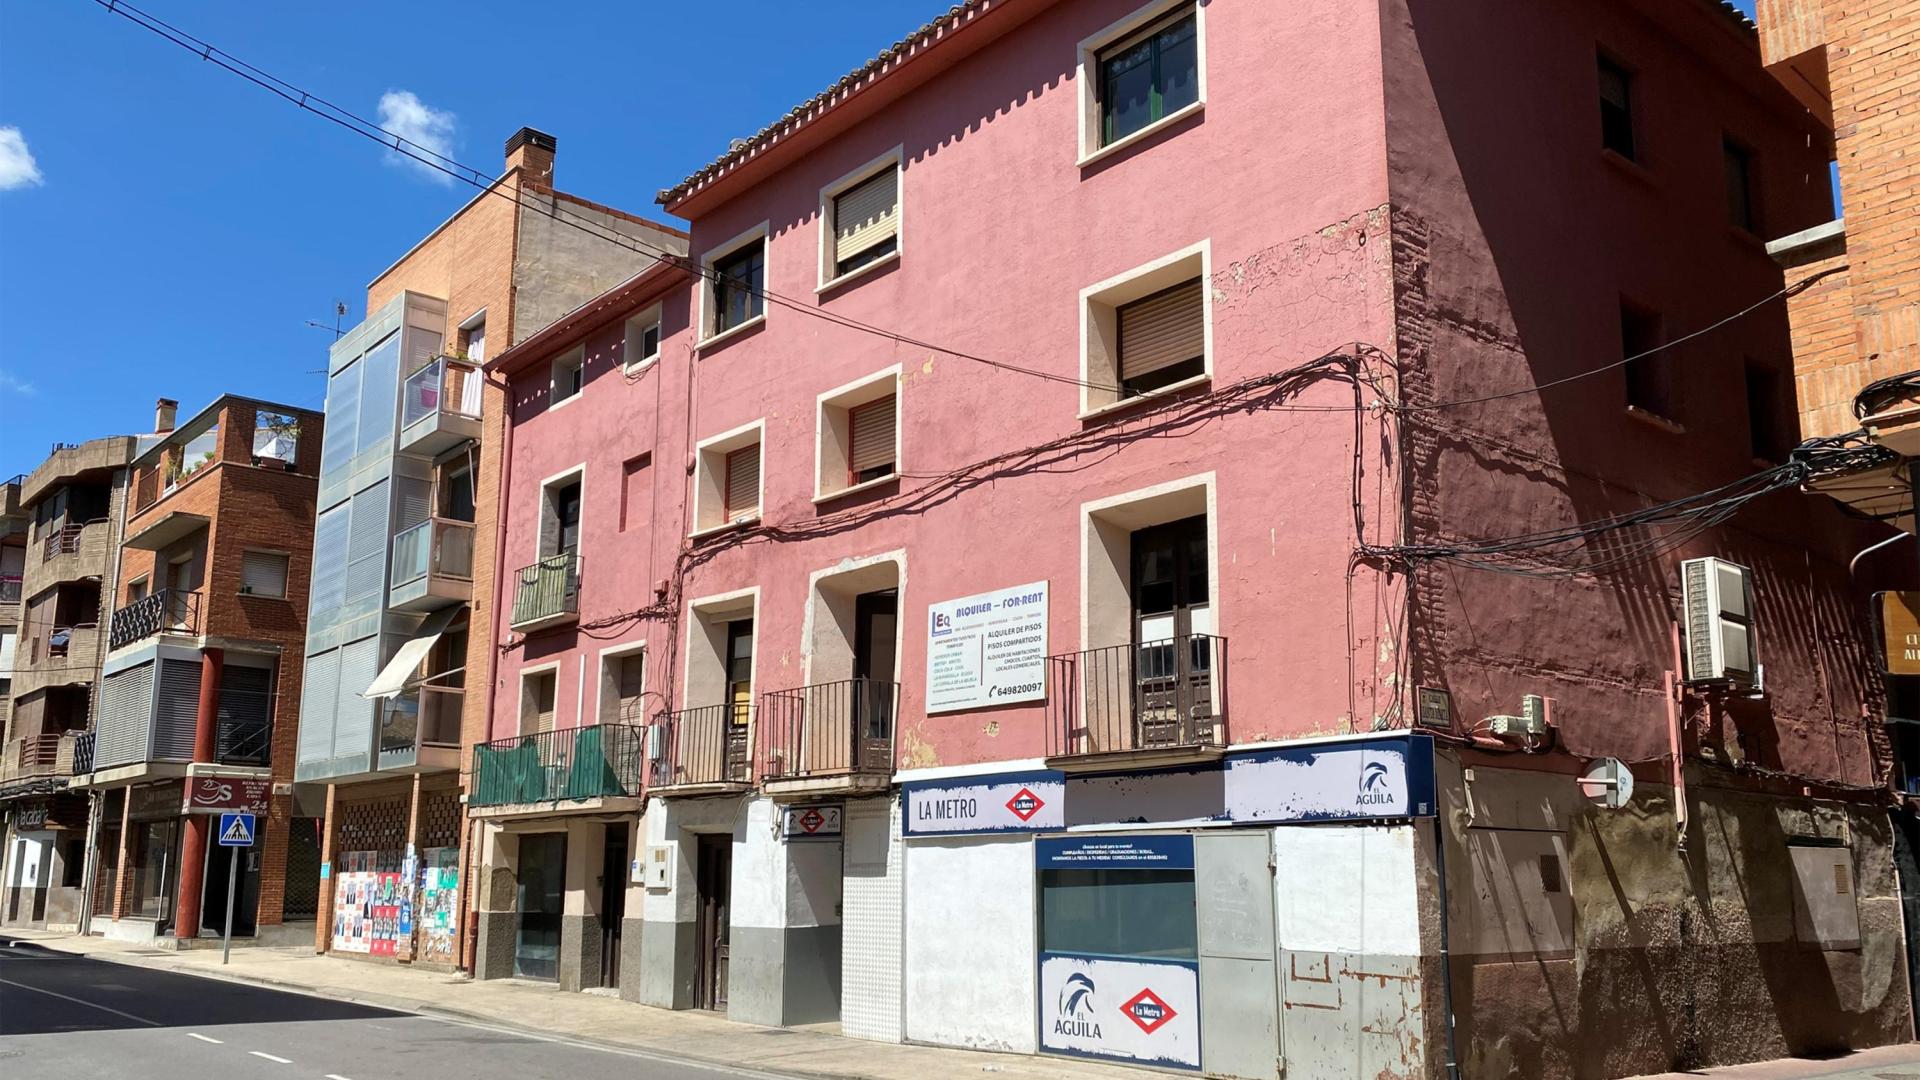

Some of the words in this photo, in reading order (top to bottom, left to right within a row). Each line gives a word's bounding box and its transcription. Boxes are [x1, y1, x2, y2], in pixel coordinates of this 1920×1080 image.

[956, 602, 992, 618] ALQUILER
[1002, 592, 1044, 609] FOR-RENT
[987, 627, 1016, 638] ALQUILER
[1016, 626, 1023, 634] DE
[1025, 622, 1042, 632] PISOS
[987, 641, 1002, 650] PISOS
[1003, 635, 1042, 648] COMPARTIDOS
[997, 682, 1043, 697] 649820097
[251, 800, 268, 810] 24
[919, 801, 932, 820] LA
[936, 798, 977, 820] METRO
[1021, 800, 1034, 809] Metro
[1077, 1012, 1085, 1021] EL
[1135, 1004, 1143, 1015] La
[1143, 1005, 1160, 1017] Metro
